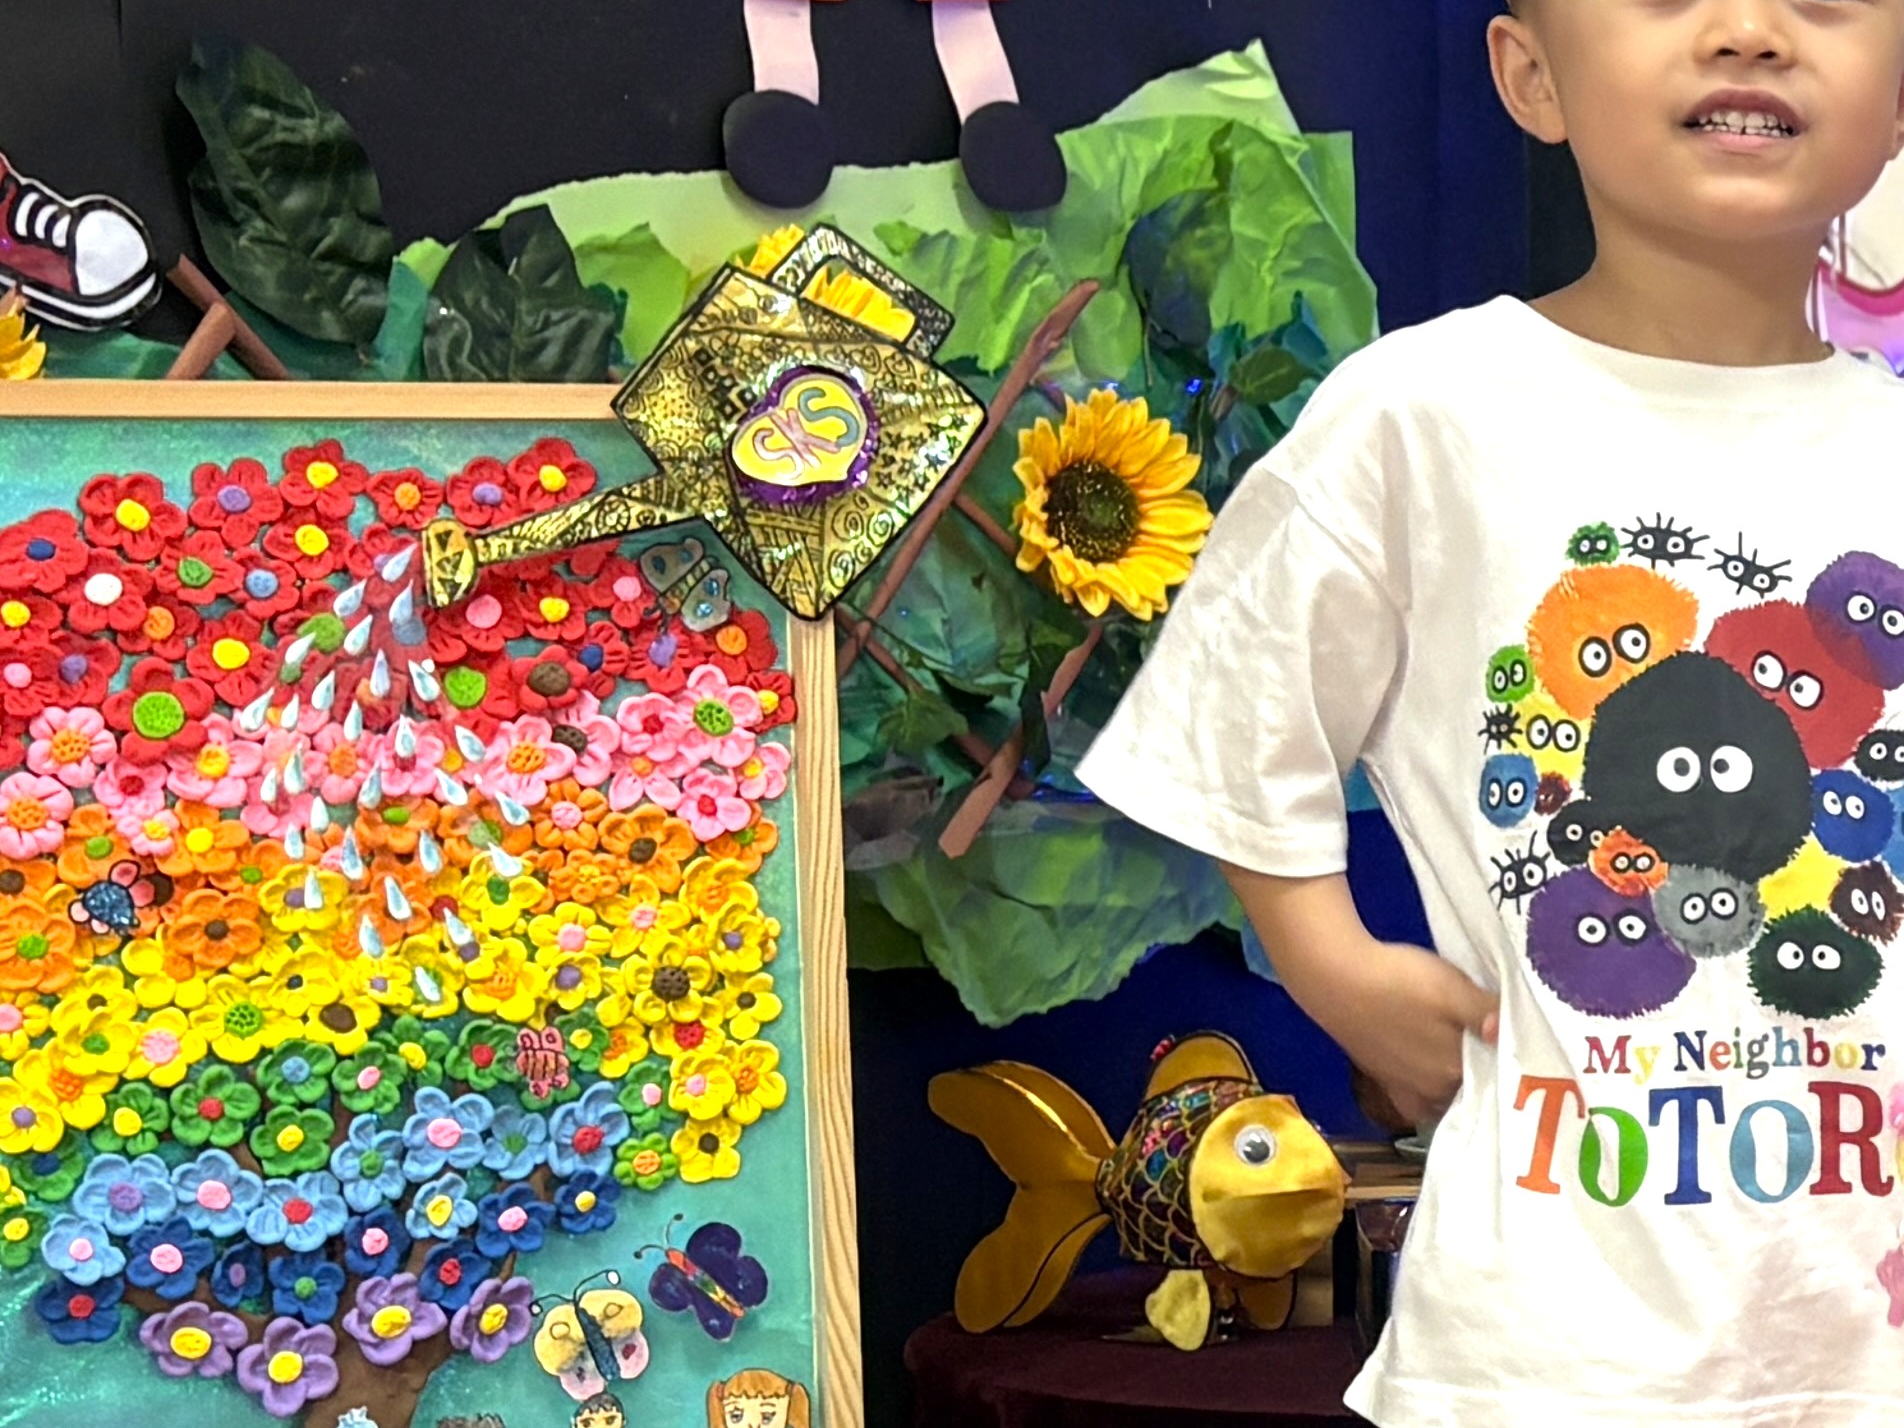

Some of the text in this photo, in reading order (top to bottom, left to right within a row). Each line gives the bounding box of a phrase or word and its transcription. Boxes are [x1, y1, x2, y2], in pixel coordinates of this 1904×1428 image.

[752, 385, 861, 480] SKS
[1583, 1026, 1886, 1085] My Neighbor
